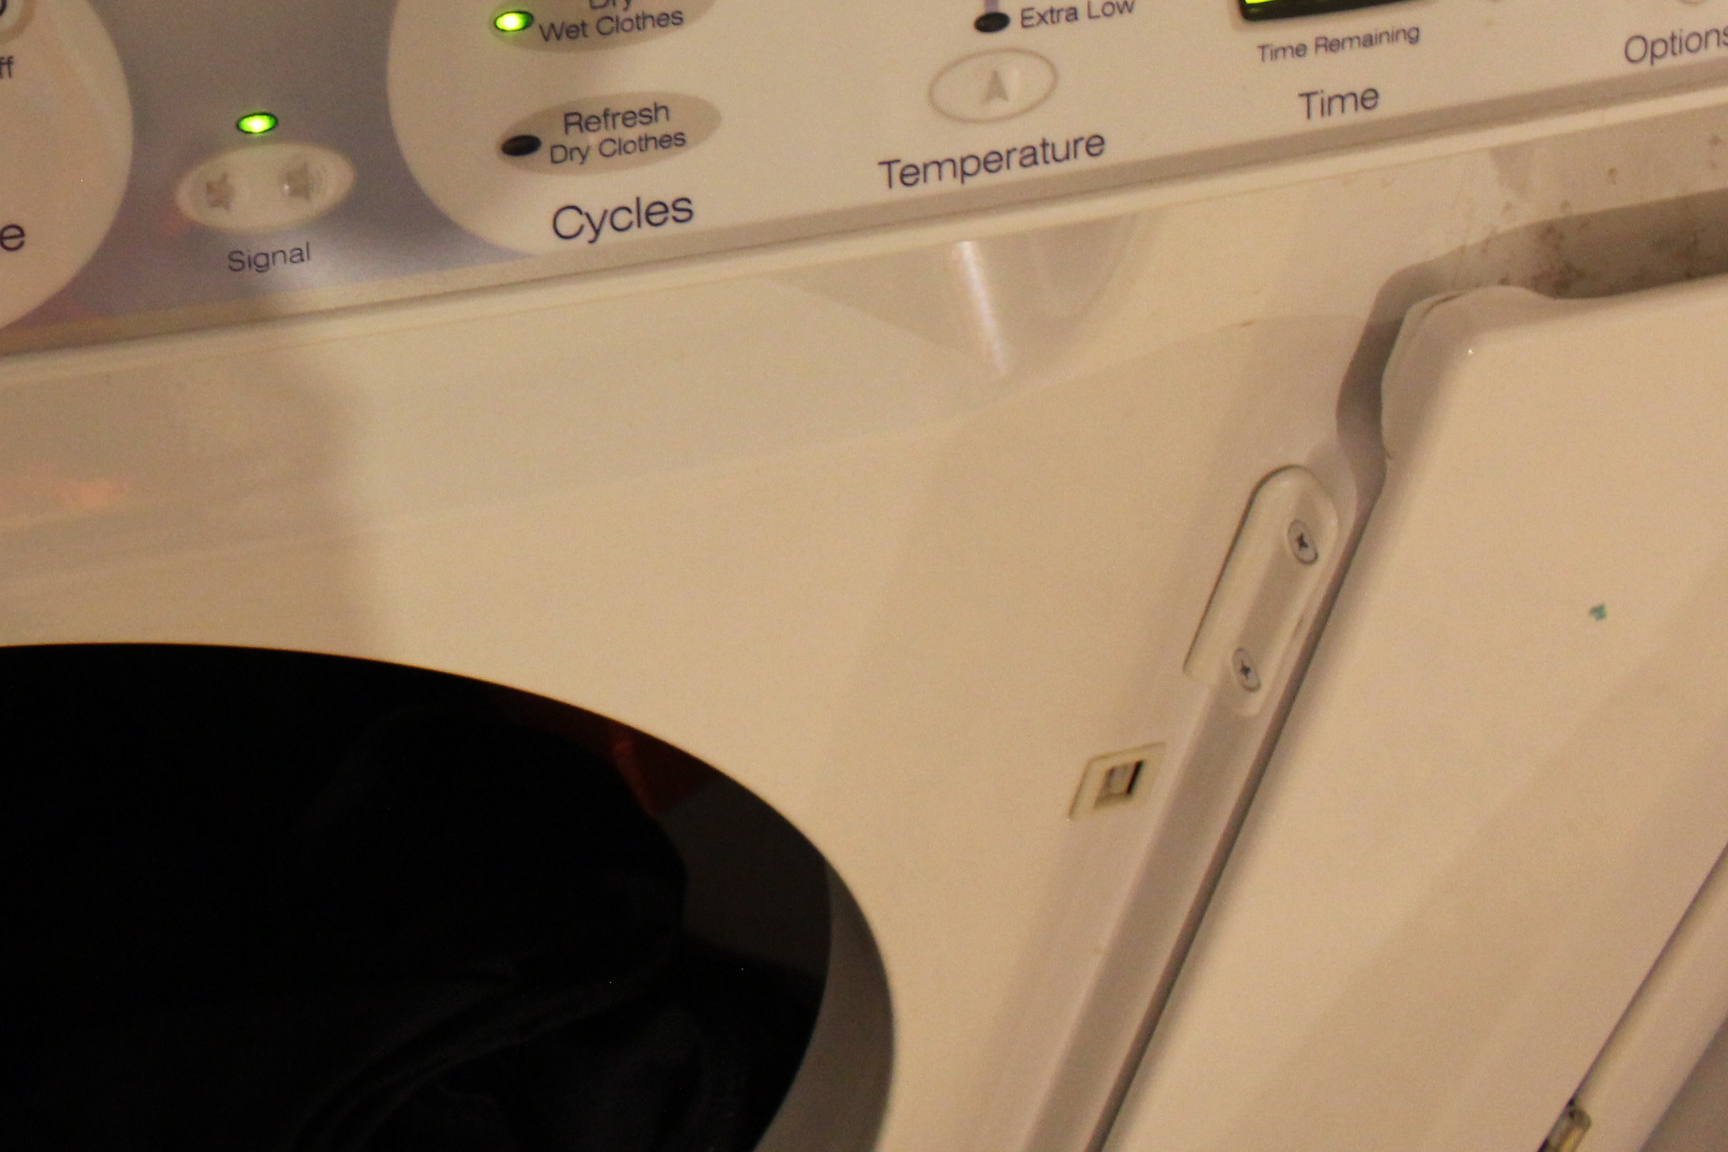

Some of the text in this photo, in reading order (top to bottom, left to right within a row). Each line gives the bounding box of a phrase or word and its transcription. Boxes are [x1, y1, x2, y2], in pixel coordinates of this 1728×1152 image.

[539, 7, 685, 43] Wet Clothes
[1021, 5, 1079, 29] Extra
[1257, 24, 1421, 63] Time Remaining
[563, 101, 670, 136] Refresh
[1298, 86, 1380, 120] Time
[549, 129, 687, 167] Dry Clothes
[878, 133, 1106, 190] Temperature
[552, 195, 695, 245] Cycles
[227, 241, 312, 276] Signal
